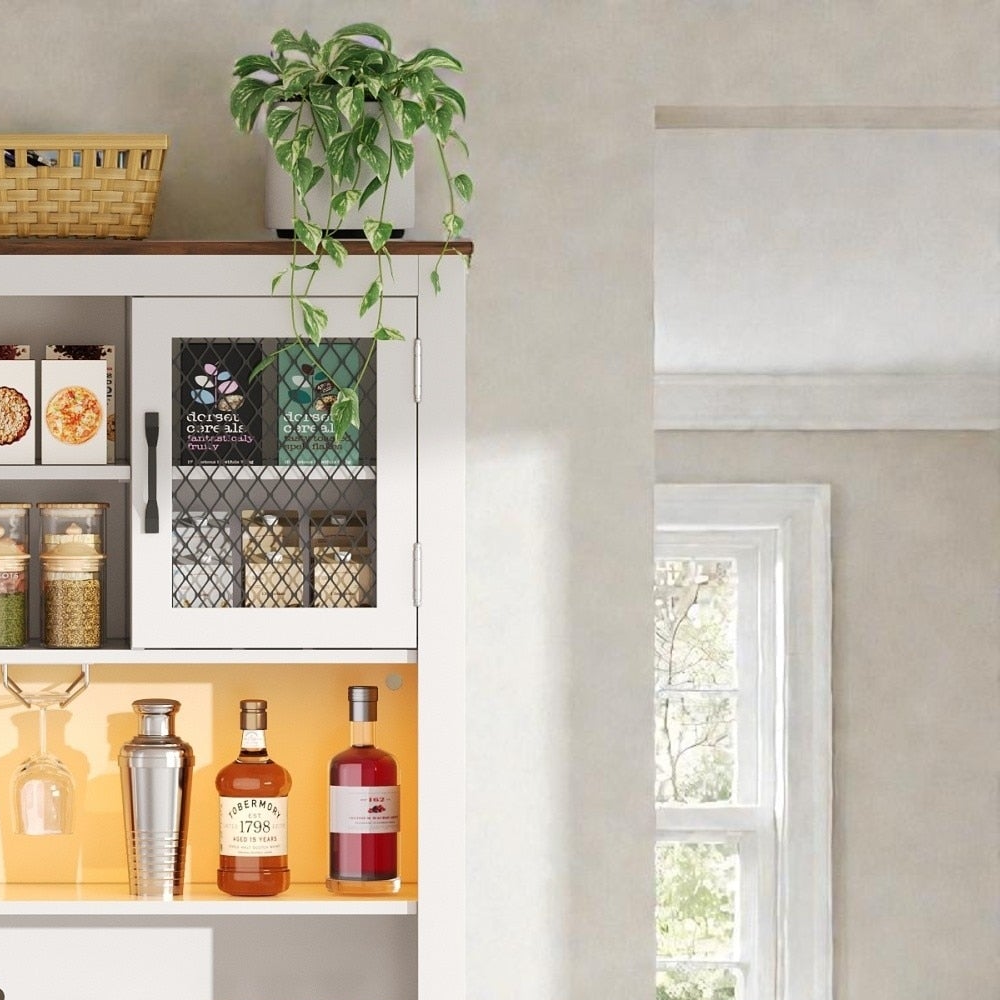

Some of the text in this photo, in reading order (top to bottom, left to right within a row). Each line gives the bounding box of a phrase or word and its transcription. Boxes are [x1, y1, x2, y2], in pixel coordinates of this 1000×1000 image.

[283, 423, 335, 434] cereal
[187, 442, 220, 450] fruiy
[228, 799, 281, 820] TOBERMORY
[240, 820, 271, 834] 1798
